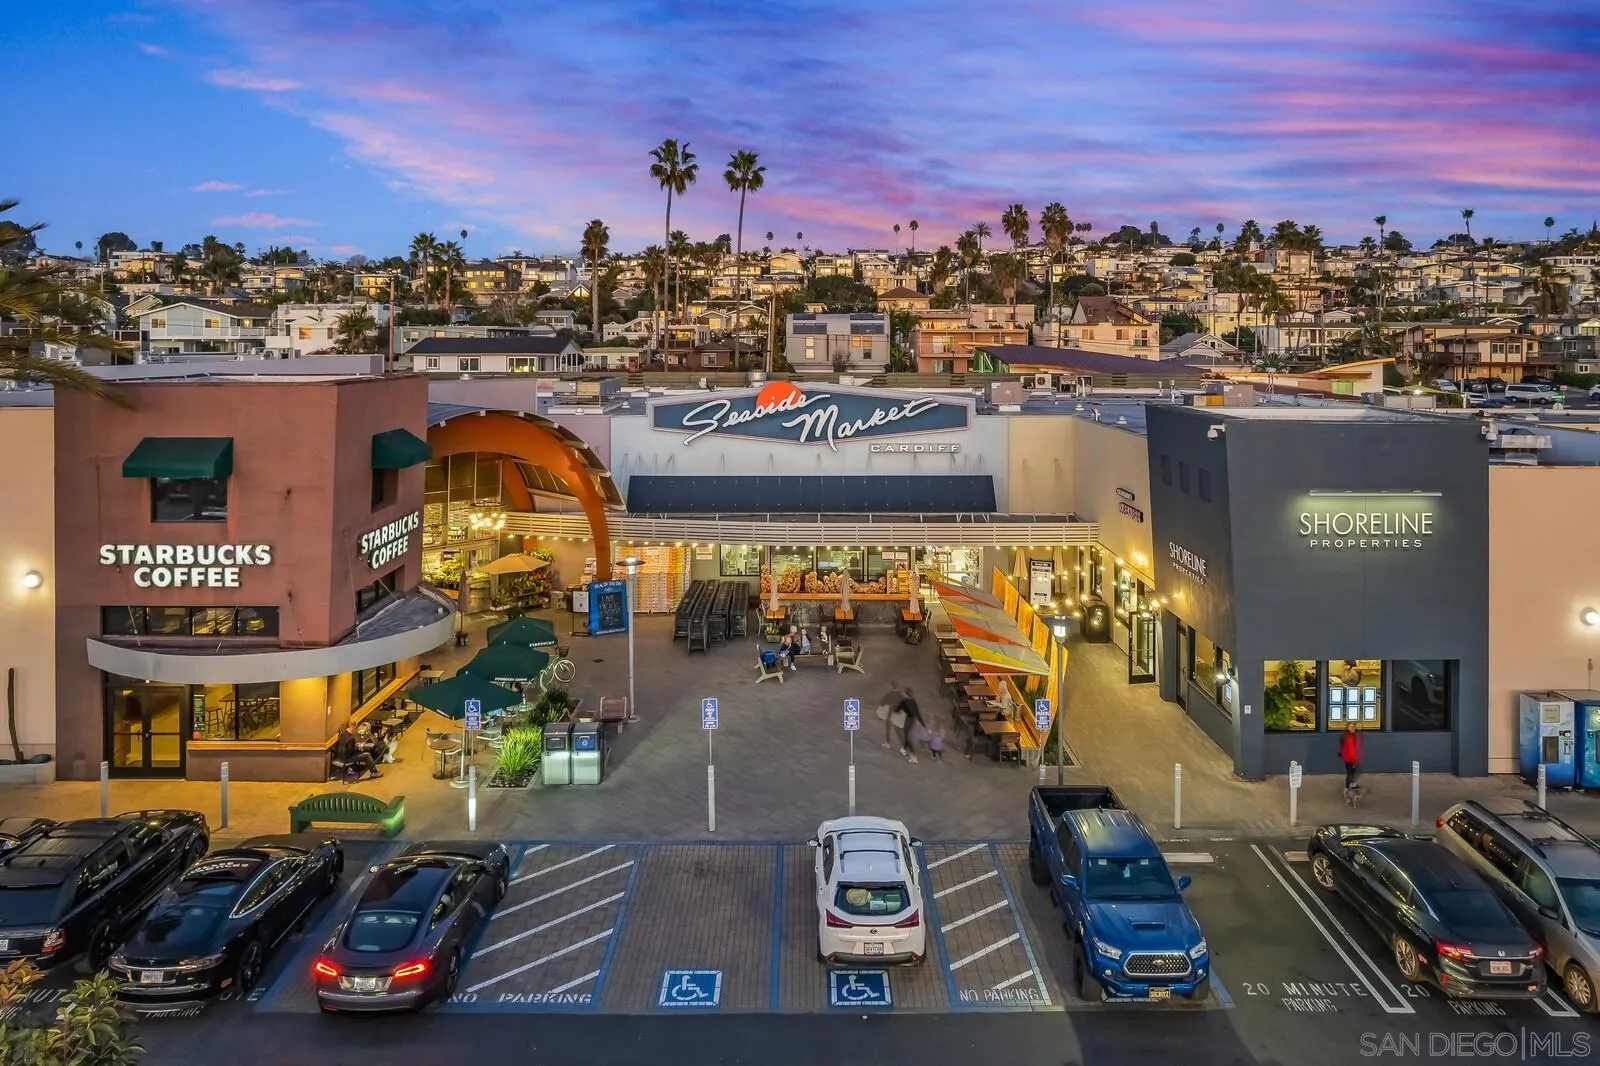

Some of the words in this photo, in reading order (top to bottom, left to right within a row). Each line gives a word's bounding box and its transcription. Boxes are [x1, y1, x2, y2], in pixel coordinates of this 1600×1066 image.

[682, 390, 831, 446] Seaside
[781, 397, 940, 452] Market
[870, 444, 961, 453] CARDIFF
[361, 511, 419, 554] STARBUCKS
[1299, 512, 1434, 535] SHORELINE
[372, 535, 409, 569] COFFEE
[1309, 539, 1423, 548] PROPERTIES
[100, 544, 272, 566] STARBUCKS
[1169, 541, 1207, 577] SHORELINE
[133, 566, 241, 589] COFFEE
[498, 992, 592, 1004] PARKING
[960, 989, 979, 1001] NO
[983, 988, 1040, 1001] PARKING
[1242, 982, 1270, 996] 20
[1281, 982, 1368, 997] MINUTE
[1400, 983, 1430, 998] 20
[1281, 997, 1338, 1012] PARKING
